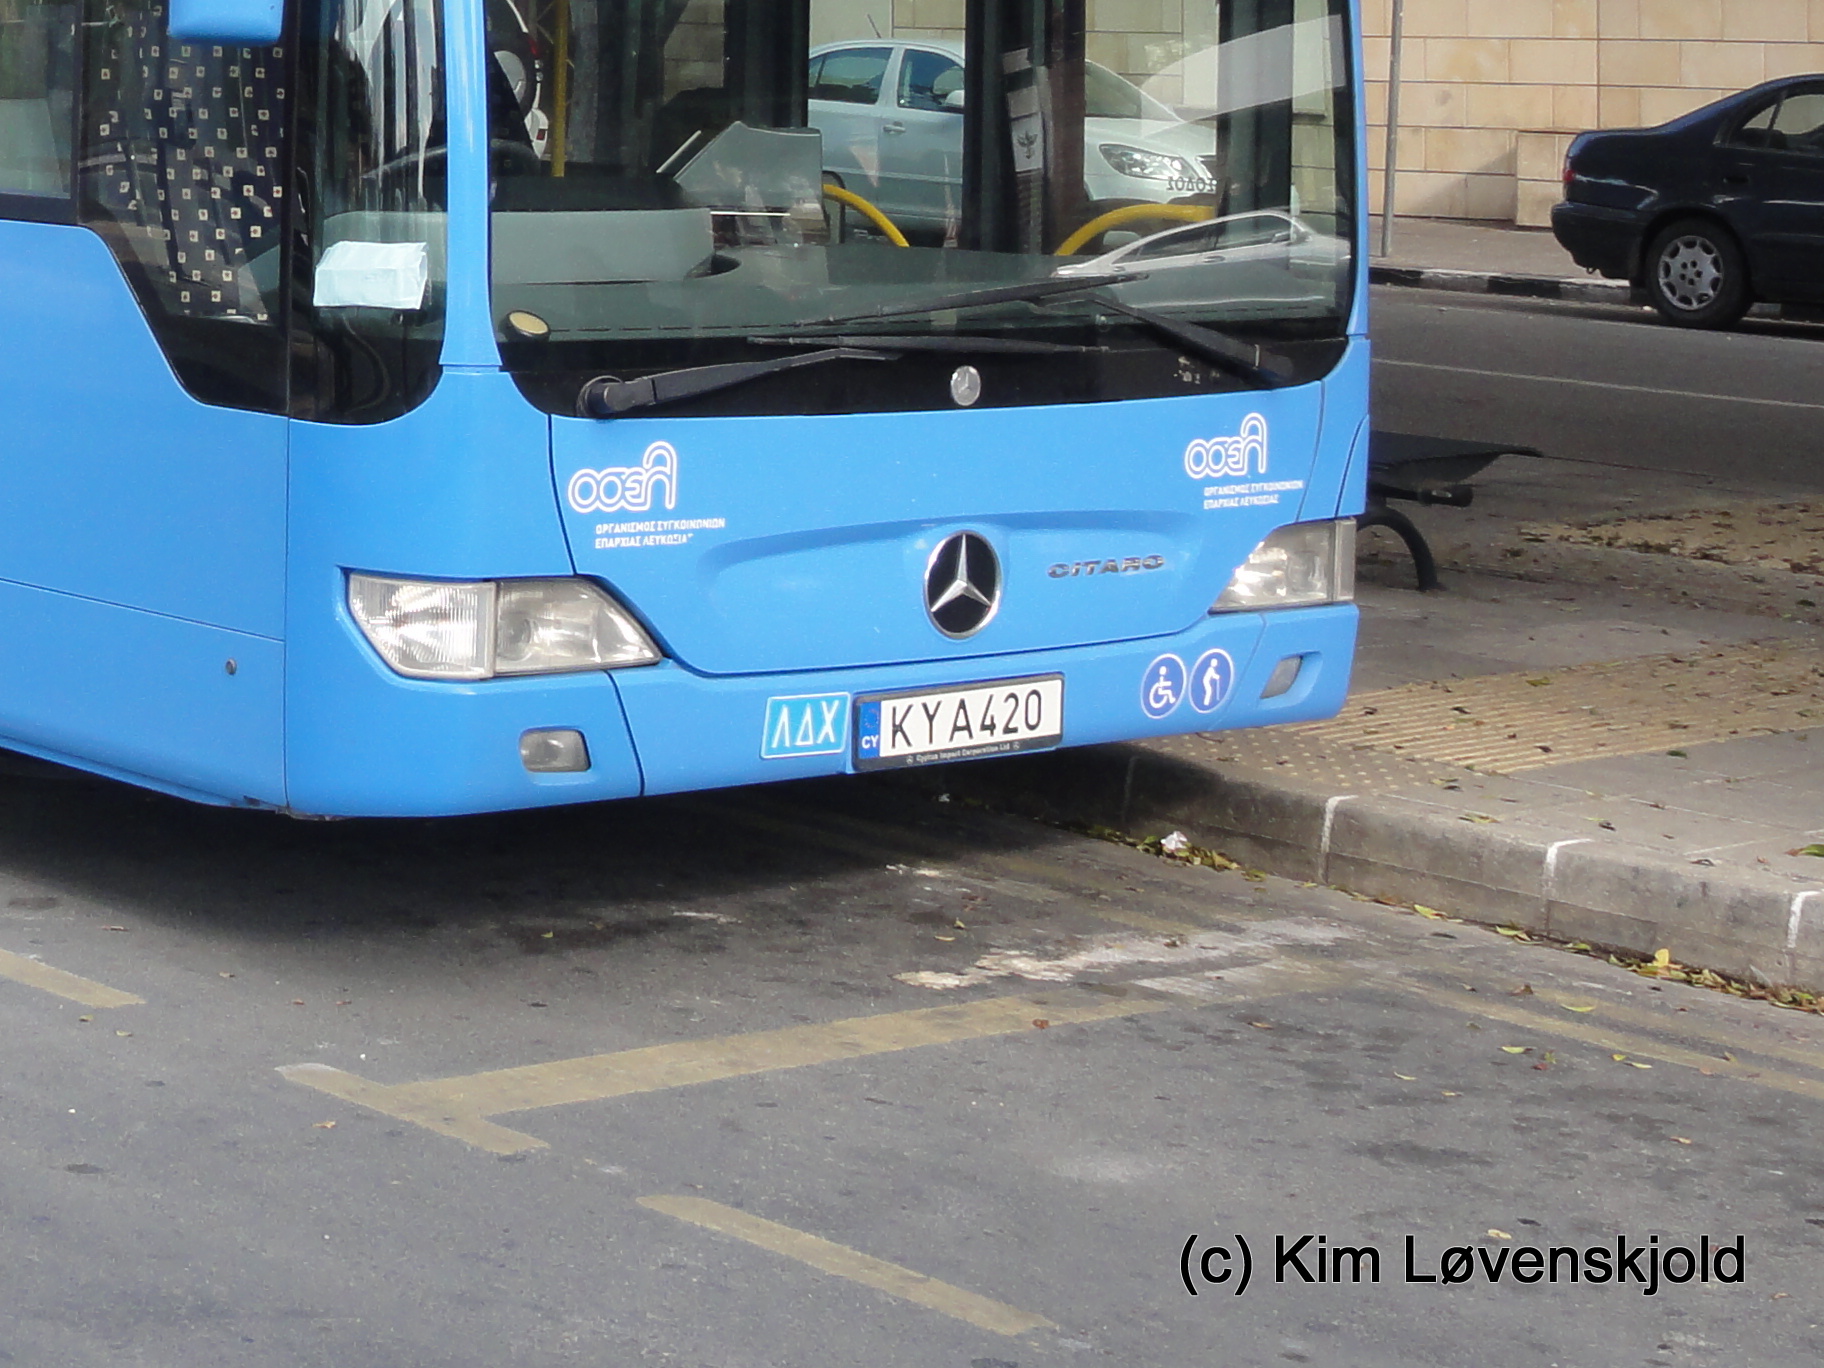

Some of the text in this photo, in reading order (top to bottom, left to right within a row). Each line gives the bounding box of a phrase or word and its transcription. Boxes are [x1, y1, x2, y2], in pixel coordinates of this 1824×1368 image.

[595, 520, 656, 535] ΟΡΓΑΝΙΣΜΟΣ
[594, 535, 642, 549] ΕΠΑΡΧΙΑΣ
[1047, 554, 1165, 579] CITARO
[860, 689, 1043, 750] CY KYA420
